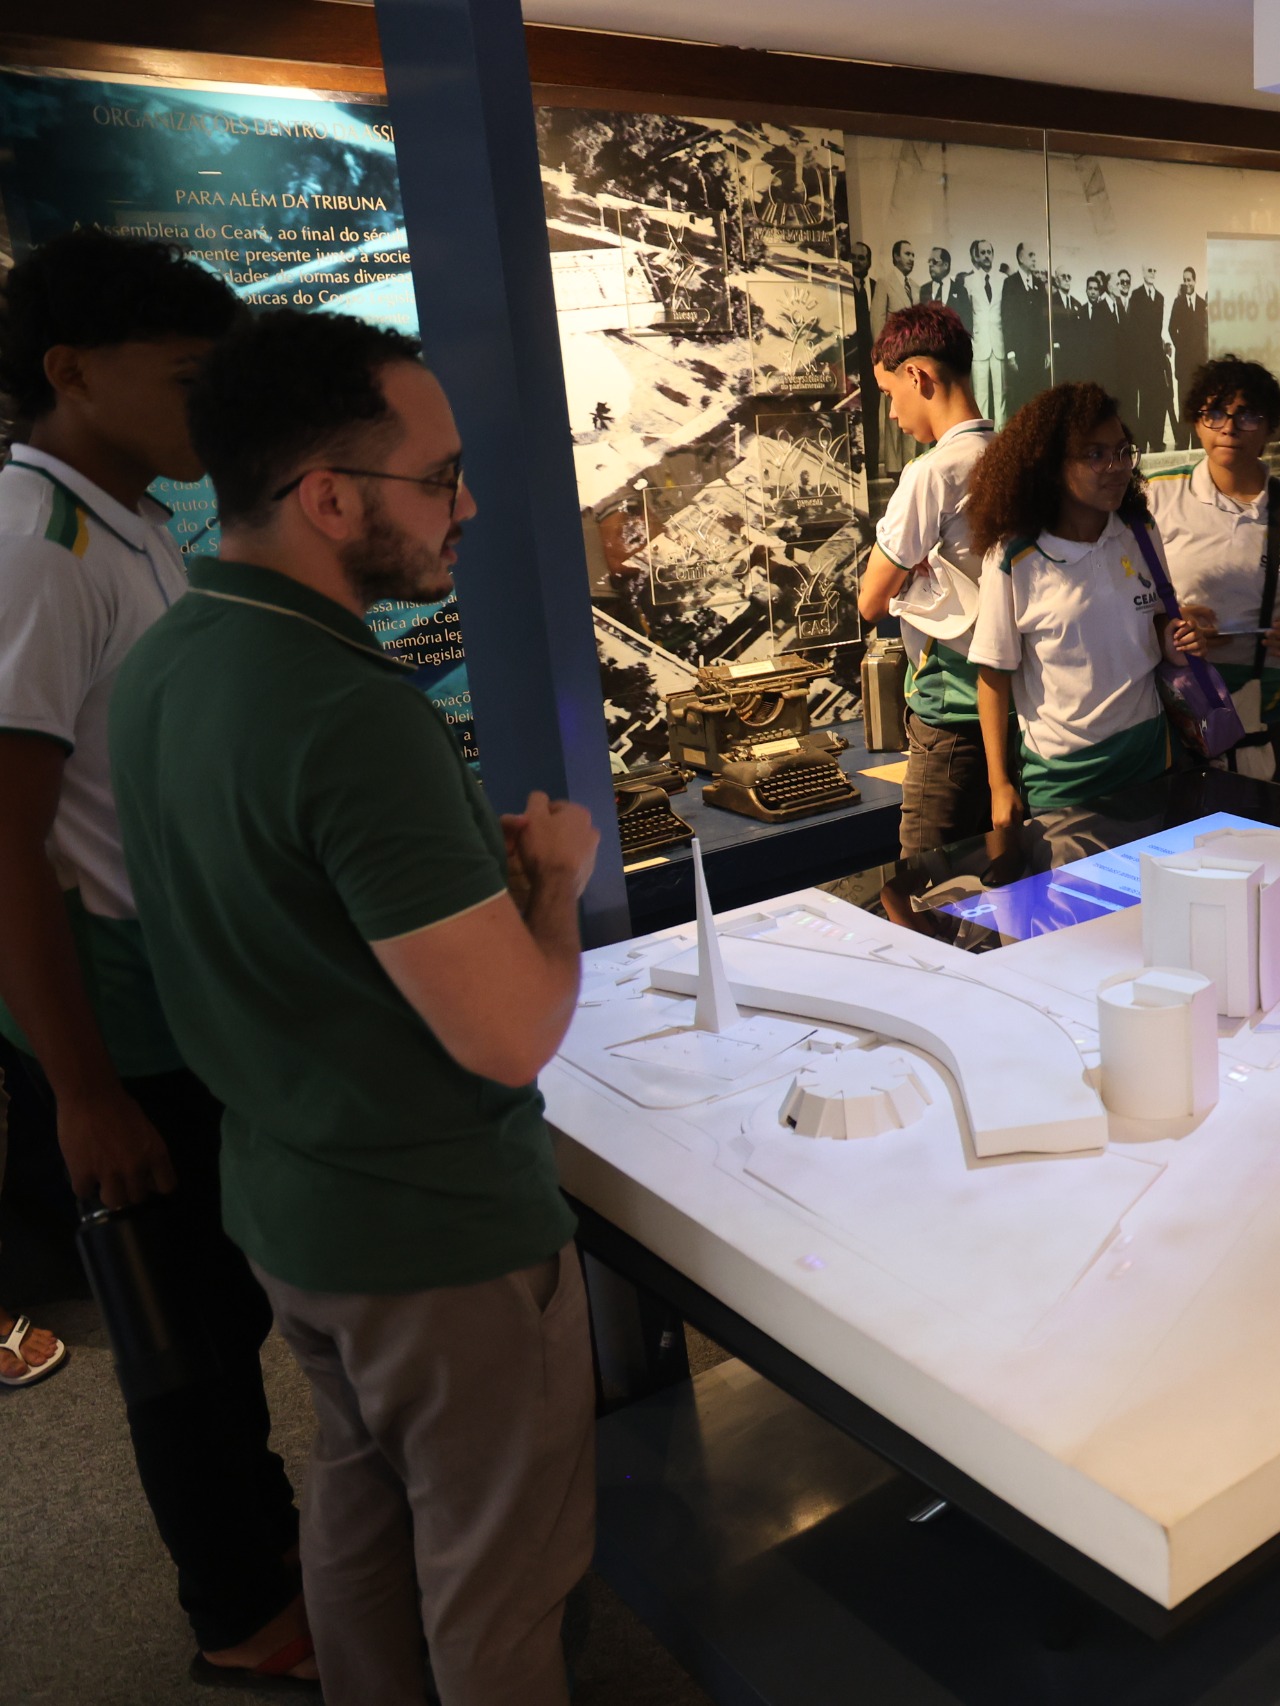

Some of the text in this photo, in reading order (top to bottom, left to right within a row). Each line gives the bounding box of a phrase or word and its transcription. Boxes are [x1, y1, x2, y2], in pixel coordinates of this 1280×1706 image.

[92, 104, 249, 138] ORGANIZAÇÕES
[254, 118, 328, 139] DENTRO
[175, 189, 387, 211] PARA ALÉM DA TRIBUNA
[194, 223, 216, 239] do
[221, 224, 273, 242] Ceará,
[278, 228, 297, 241] ao
[301, 226, 335, 241] final
[339, 227, 359, 242] do
[246, 248, 311, 265] presente
[293, 289, 313, 305] do
[177, 518, 198, 533] do
[411, 613, 429, 628] do
[433, 610, 460, 625] Cea
[382, 629, 442, 651] memória
